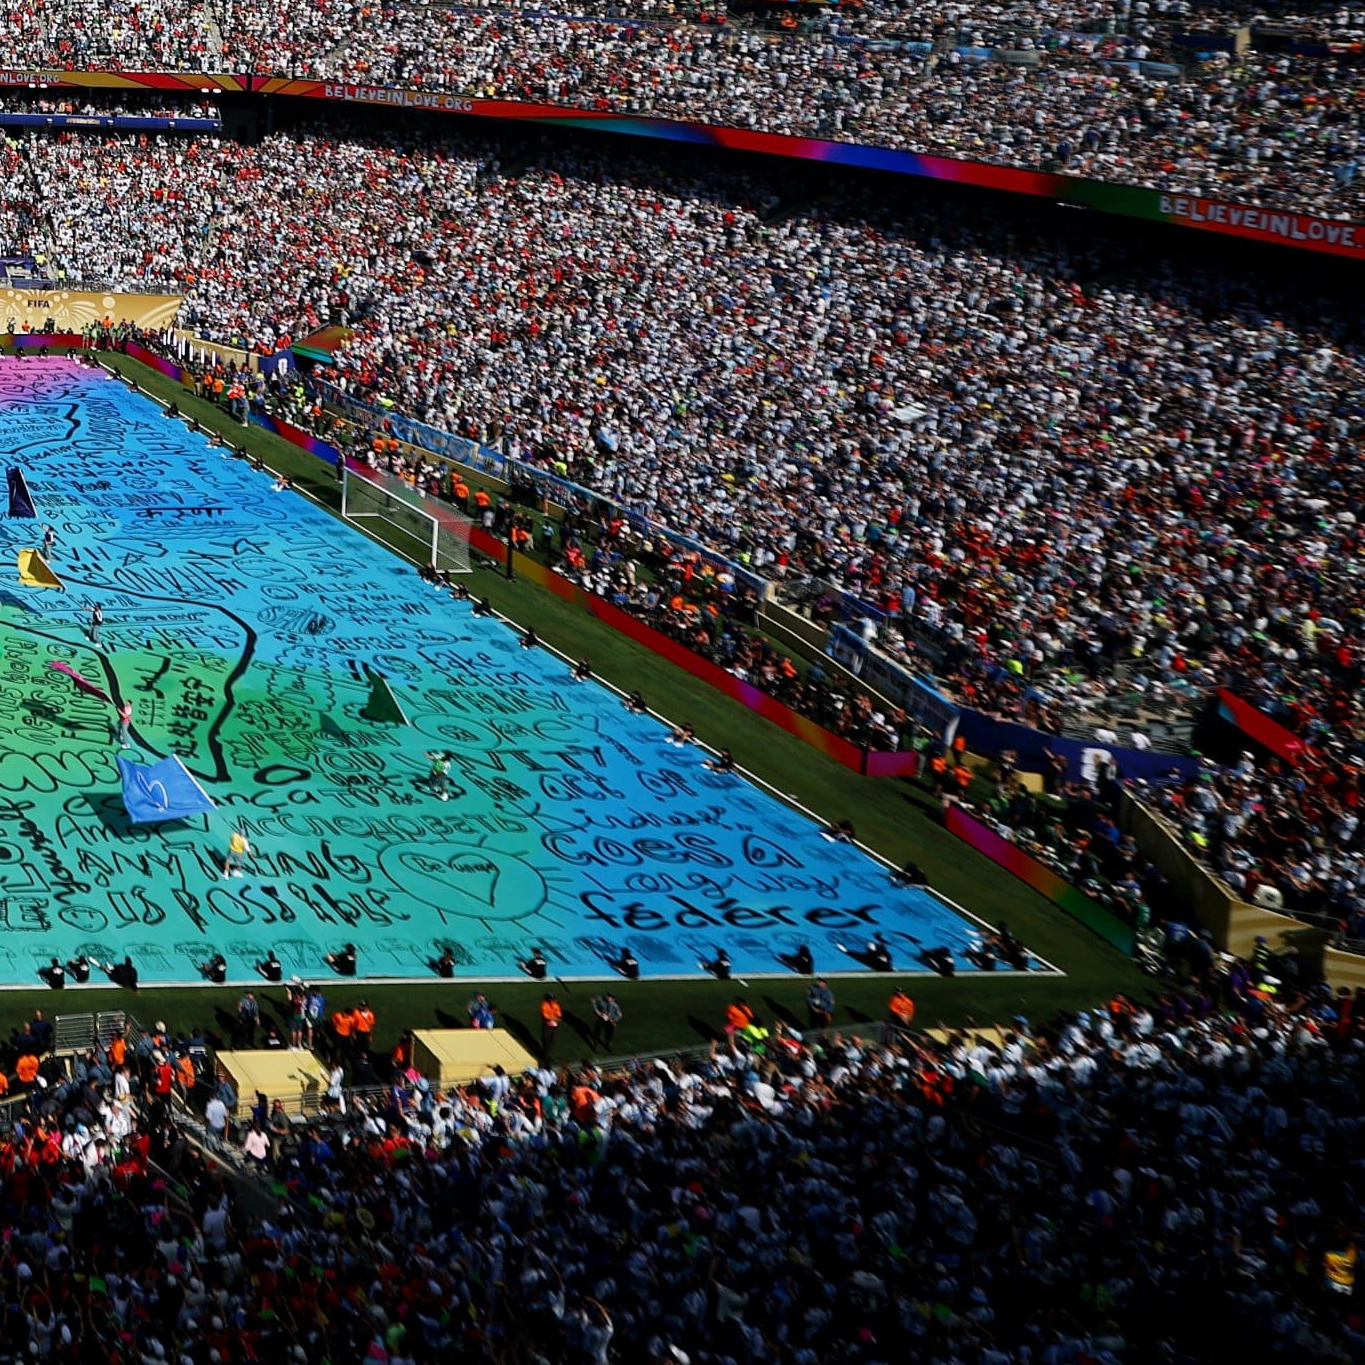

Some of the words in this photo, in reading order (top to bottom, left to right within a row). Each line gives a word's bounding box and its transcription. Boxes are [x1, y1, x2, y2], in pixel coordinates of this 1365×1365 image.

[324, 85, 473, 111] BELIEVEINLOVE.ORG
[27, 299, 51, 308] FIFA
[418, 649, 505, 676] take
[447, 670, 545, 689] action
